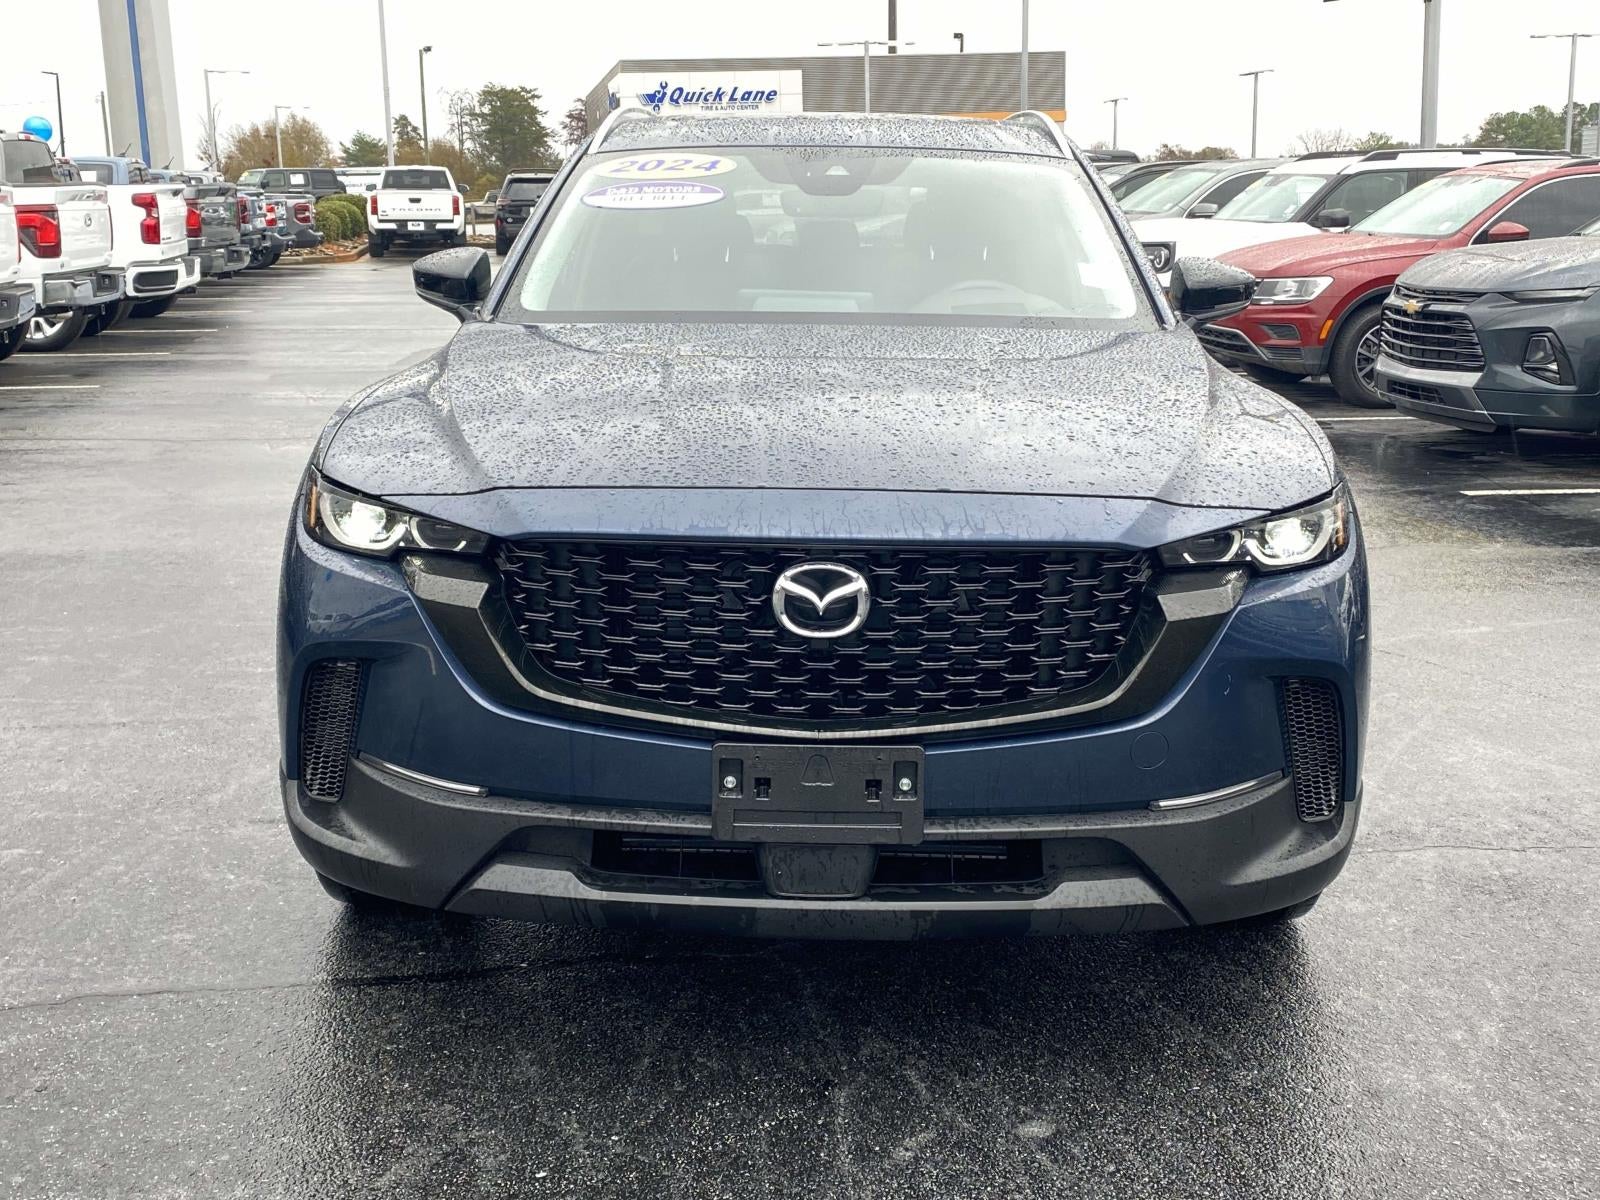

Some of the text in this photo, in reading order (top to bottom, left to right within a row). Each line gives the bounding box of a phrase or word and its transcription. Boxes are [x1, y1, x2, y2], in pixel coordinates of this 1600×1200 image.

[669, 86, 778, 104] Quick Lane
[609, 159, 721, 172] 2024
[640, 186, 702, 194] MOTORS
